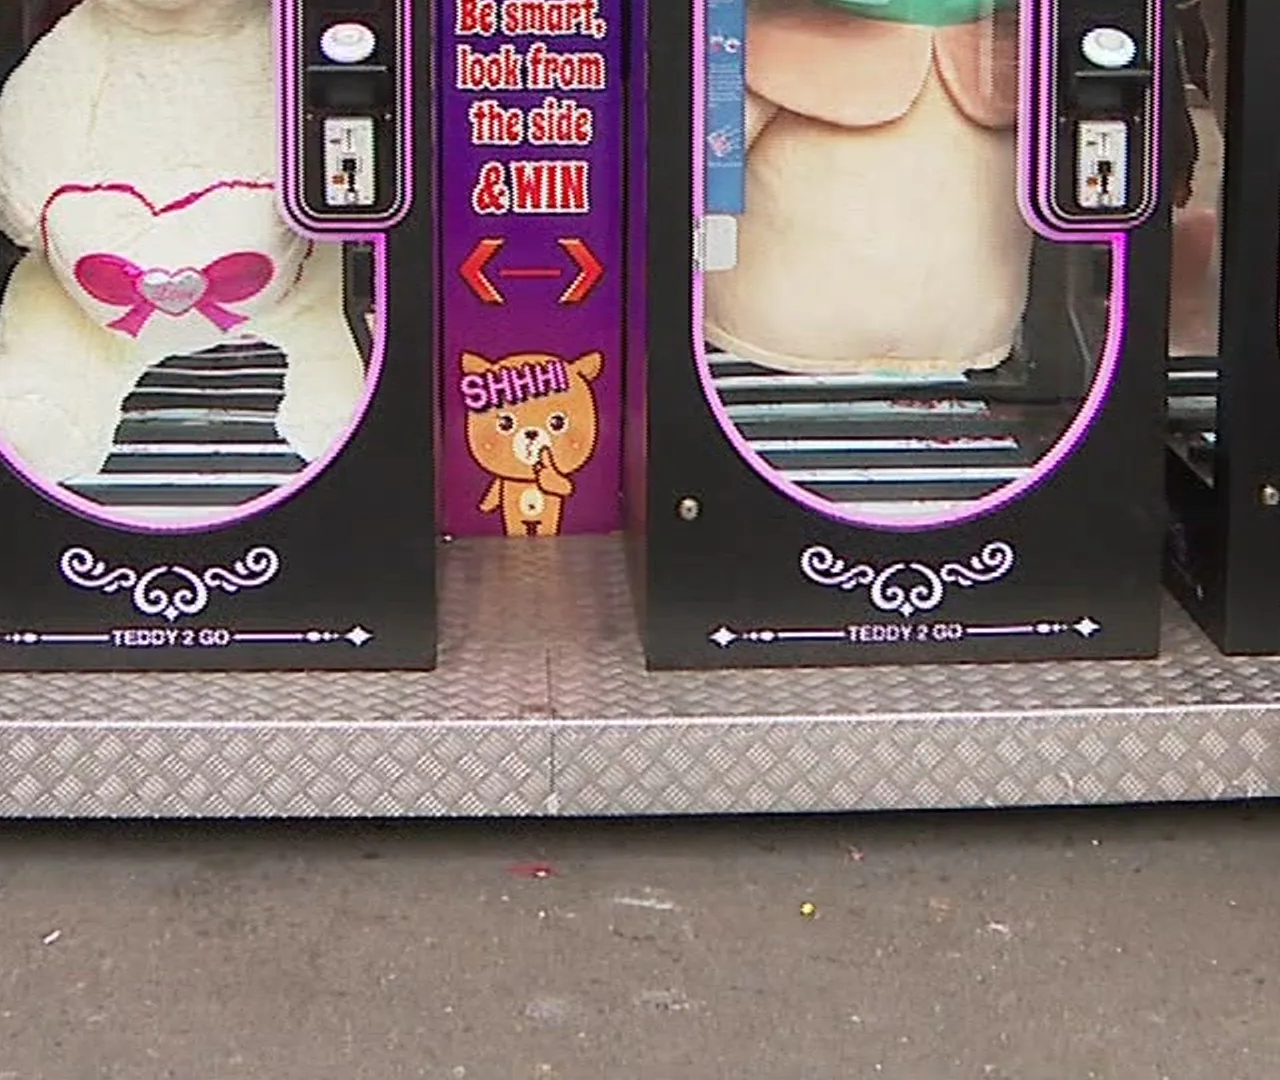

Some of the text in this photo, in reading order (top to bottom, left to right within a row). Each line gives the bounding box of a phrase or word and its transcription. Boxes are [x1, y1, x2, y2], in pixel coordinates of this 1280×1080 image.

[456, 42, 606, 89] look from
[469, 96, 593, 145] the side
[472, 160, 590, 214] & WIN
[111, 629, 230, 646] TEDDY 2 GO
[847, 623, 963, 642] TEDDY 2 GO
